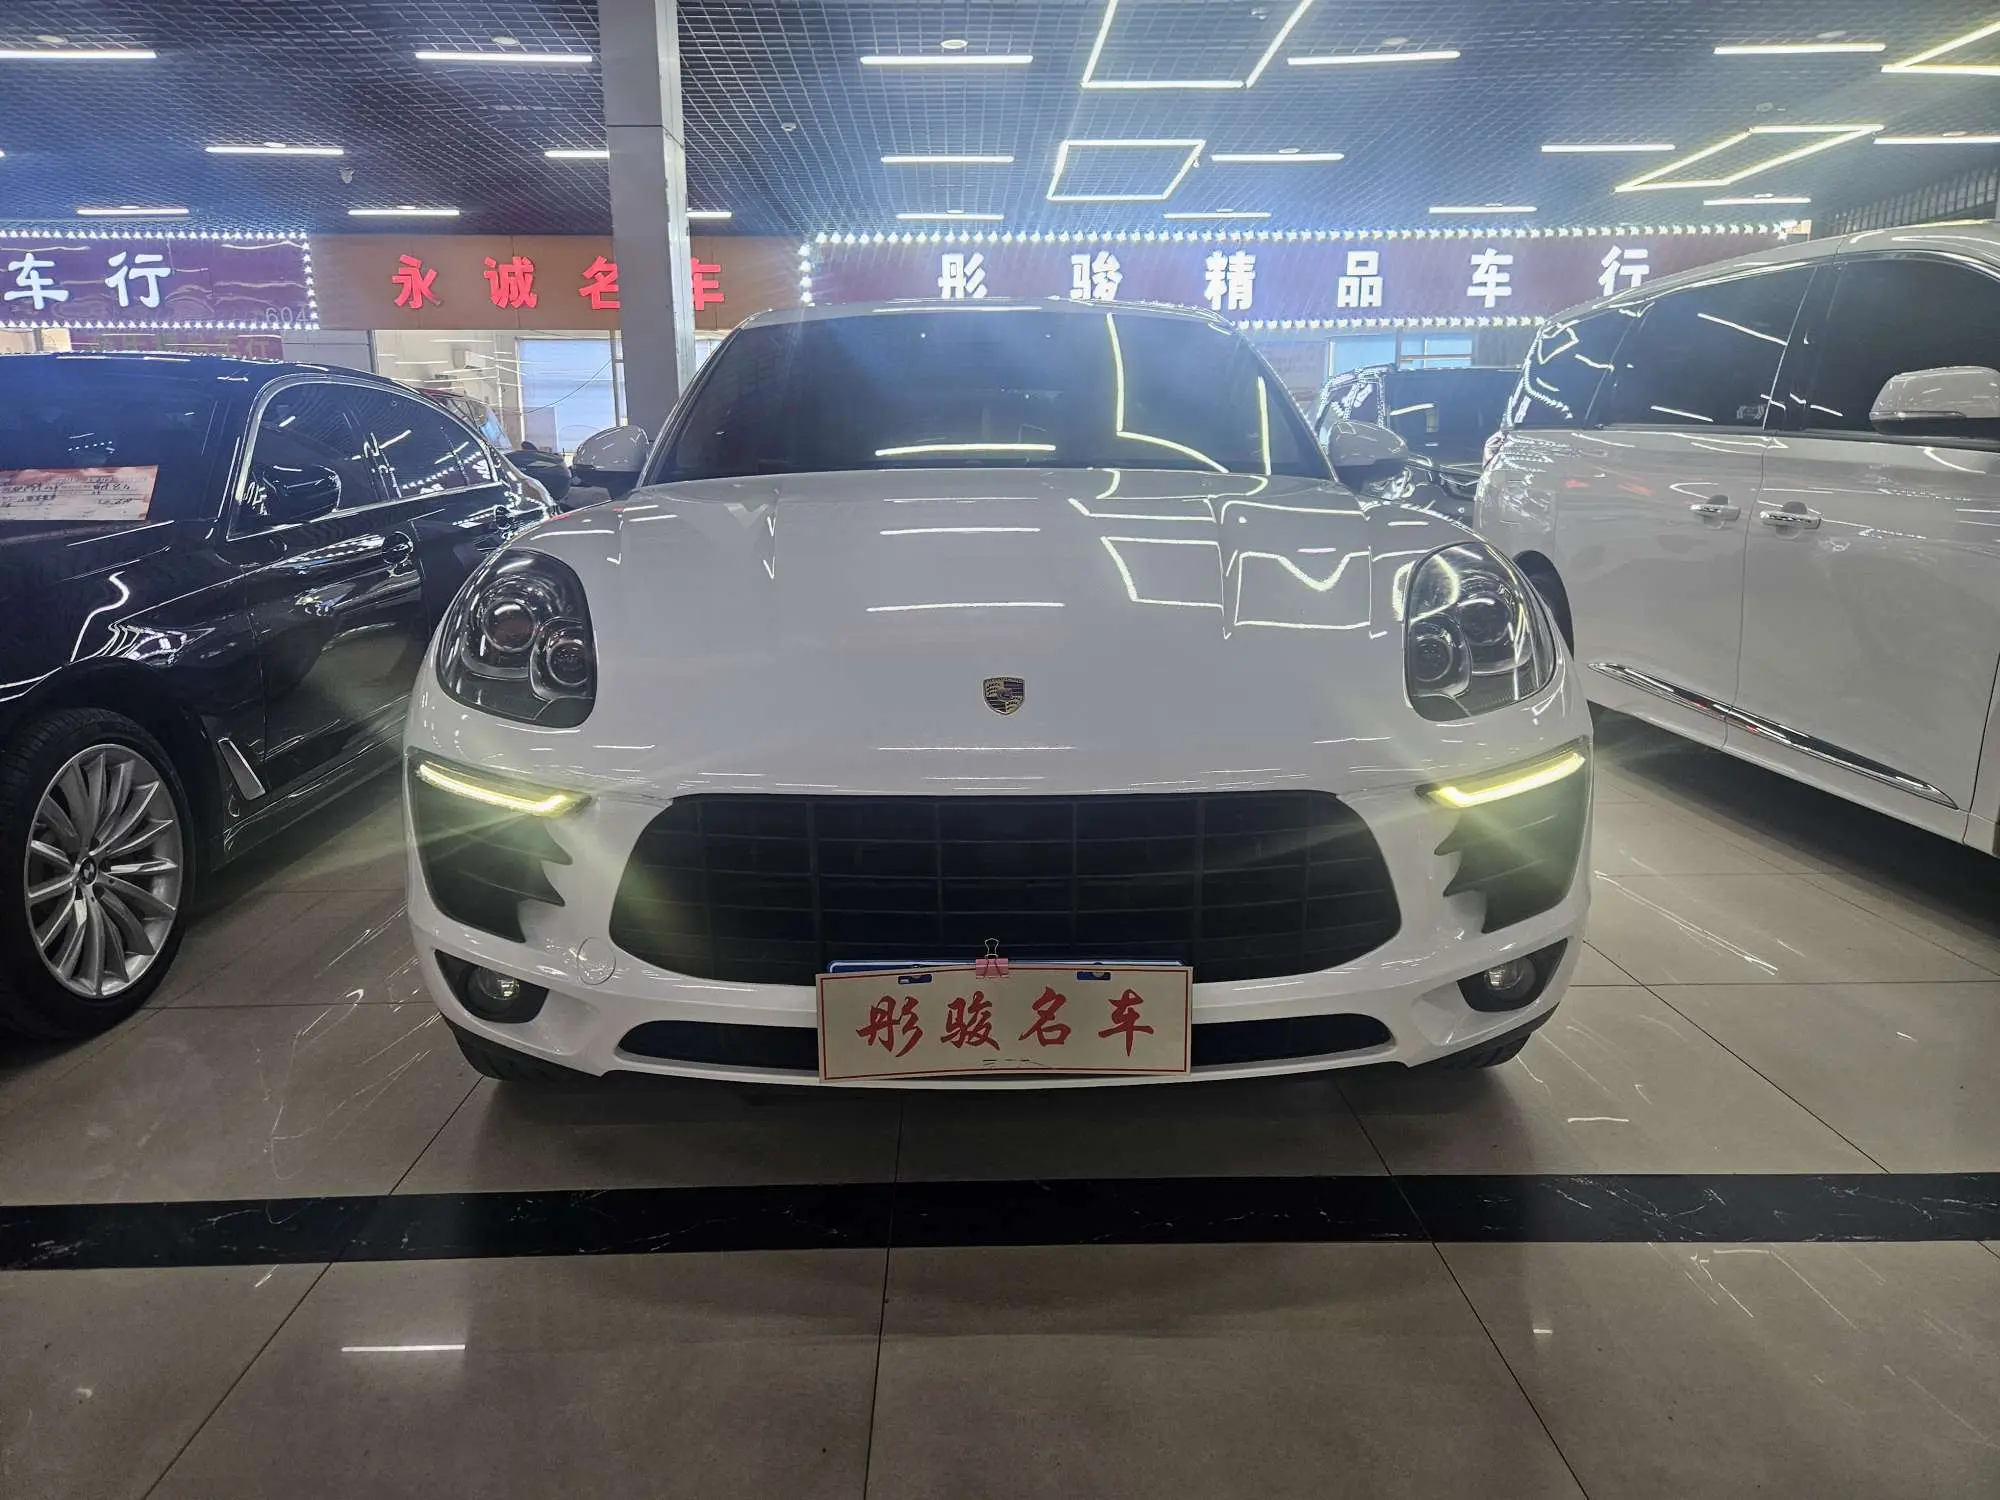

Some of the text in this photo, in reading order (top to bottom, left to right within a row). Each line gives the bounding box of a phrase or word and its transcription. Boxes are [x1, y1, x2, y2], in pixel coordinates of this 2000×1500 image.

[4, 252, 171, 311] 车行
[391, 254, 725, 311] 永诚名车
[937, 246, 1651, 311] 彤骏精品车行
[855, 986, 1155, 1058] 彤骏名车
